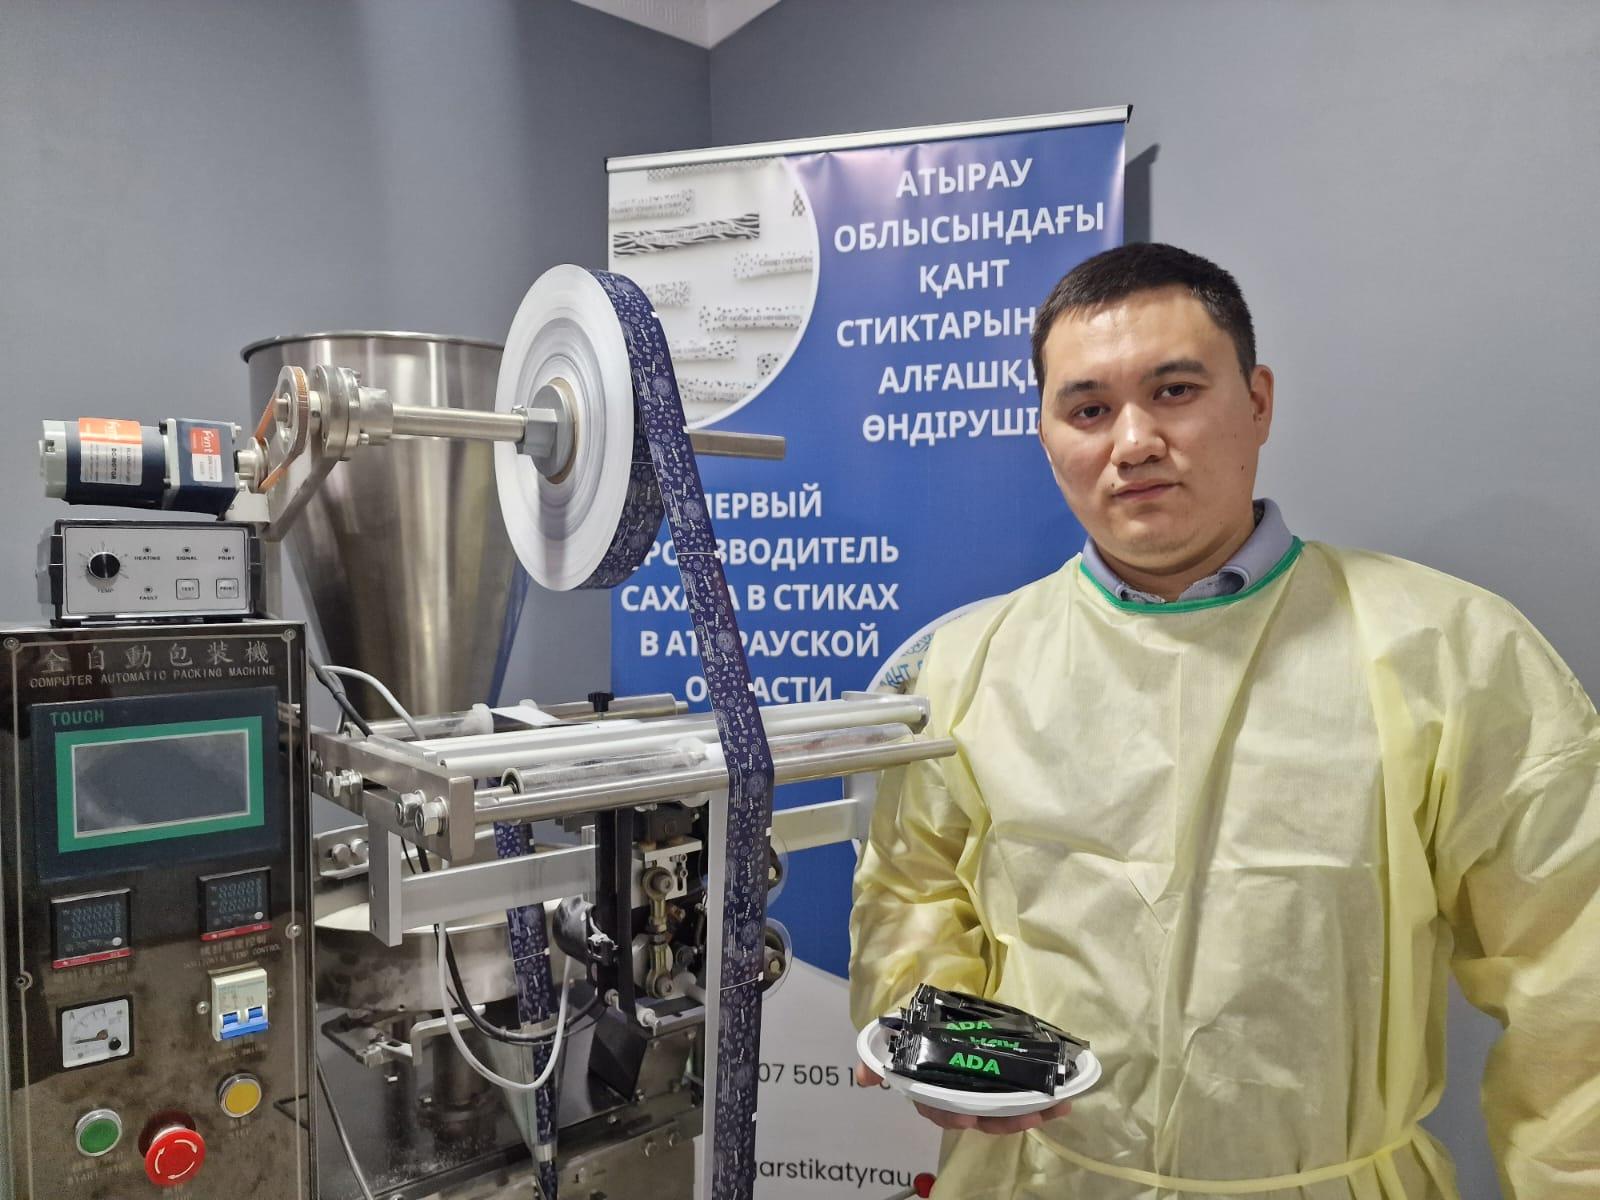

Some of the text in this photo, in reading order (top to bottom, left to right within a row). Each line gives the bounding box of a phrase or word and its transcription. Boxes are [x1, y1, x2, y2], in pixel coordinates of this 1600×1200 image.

[896, 158, 1033, 198] АТЫРАУ
[834, 202, 1104, 253] ОБЛЫСЫНДАҒЫ
[920, 259, 1010, 299] ҚАНТ
[836, 307, 1037, 347] СТИКТАРЫН
[862, 407, 1038, 446] ӨНДІРУШІ
[748, 585, 765, 611] В
[774, 584, 899, 611] СТИКАХ
[640, 630, 660, 657] В
[665, 622, 879, 657] АТАУСКОЙ
[30, 665, 275, 688] COMPUTER AUTOMATIC PACKING MACHINE
[685, 676, 832, 702] ОАСТИ
[49, 708, 105, 726] TOUCH
[945, 1021, 993, 1031] ADA
[758, 1062, 785, 1083] 07
[793, 1064, 839, 1086] 505
[949, 1051, 1001, 1075] ADA
